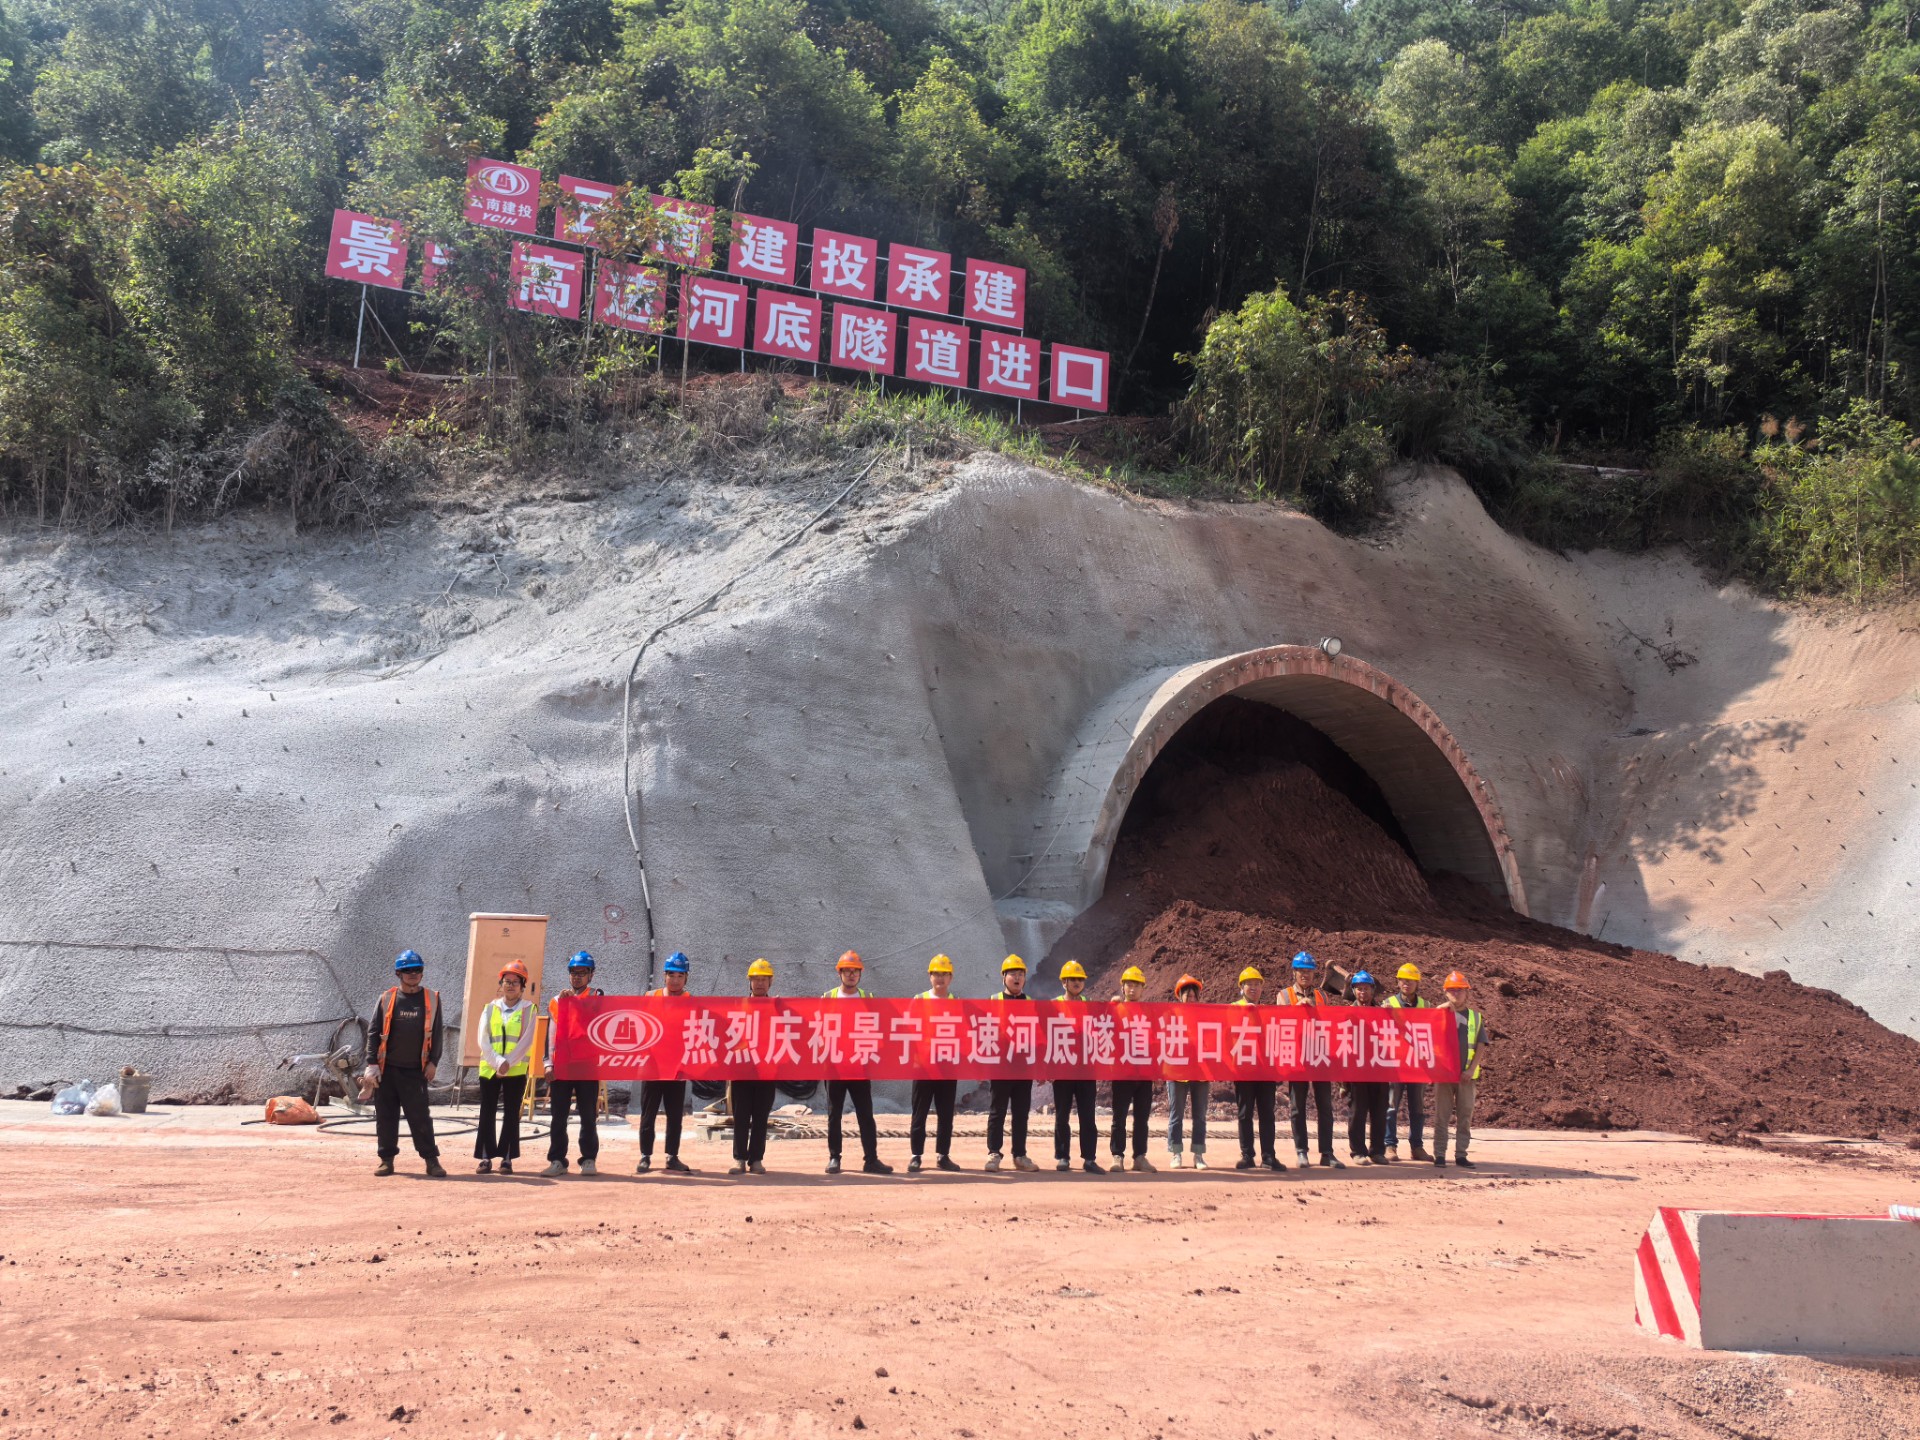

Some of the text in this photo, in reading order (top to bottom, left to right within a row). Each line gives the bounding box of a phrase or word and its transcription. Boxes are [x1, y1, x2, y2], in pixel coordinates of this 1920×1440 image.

[470, 195, 532, 218] 云南建投
[482, 212, 518, 226] YCIH
[339, 219, 1103, 403] 景高速河底隧道进口
[681, 1010, 1435, 1069] 热烈庆祝景宁高速河底隧道进口右幅顺利进洞
[597, 1054, 650, 1067] YCIH
